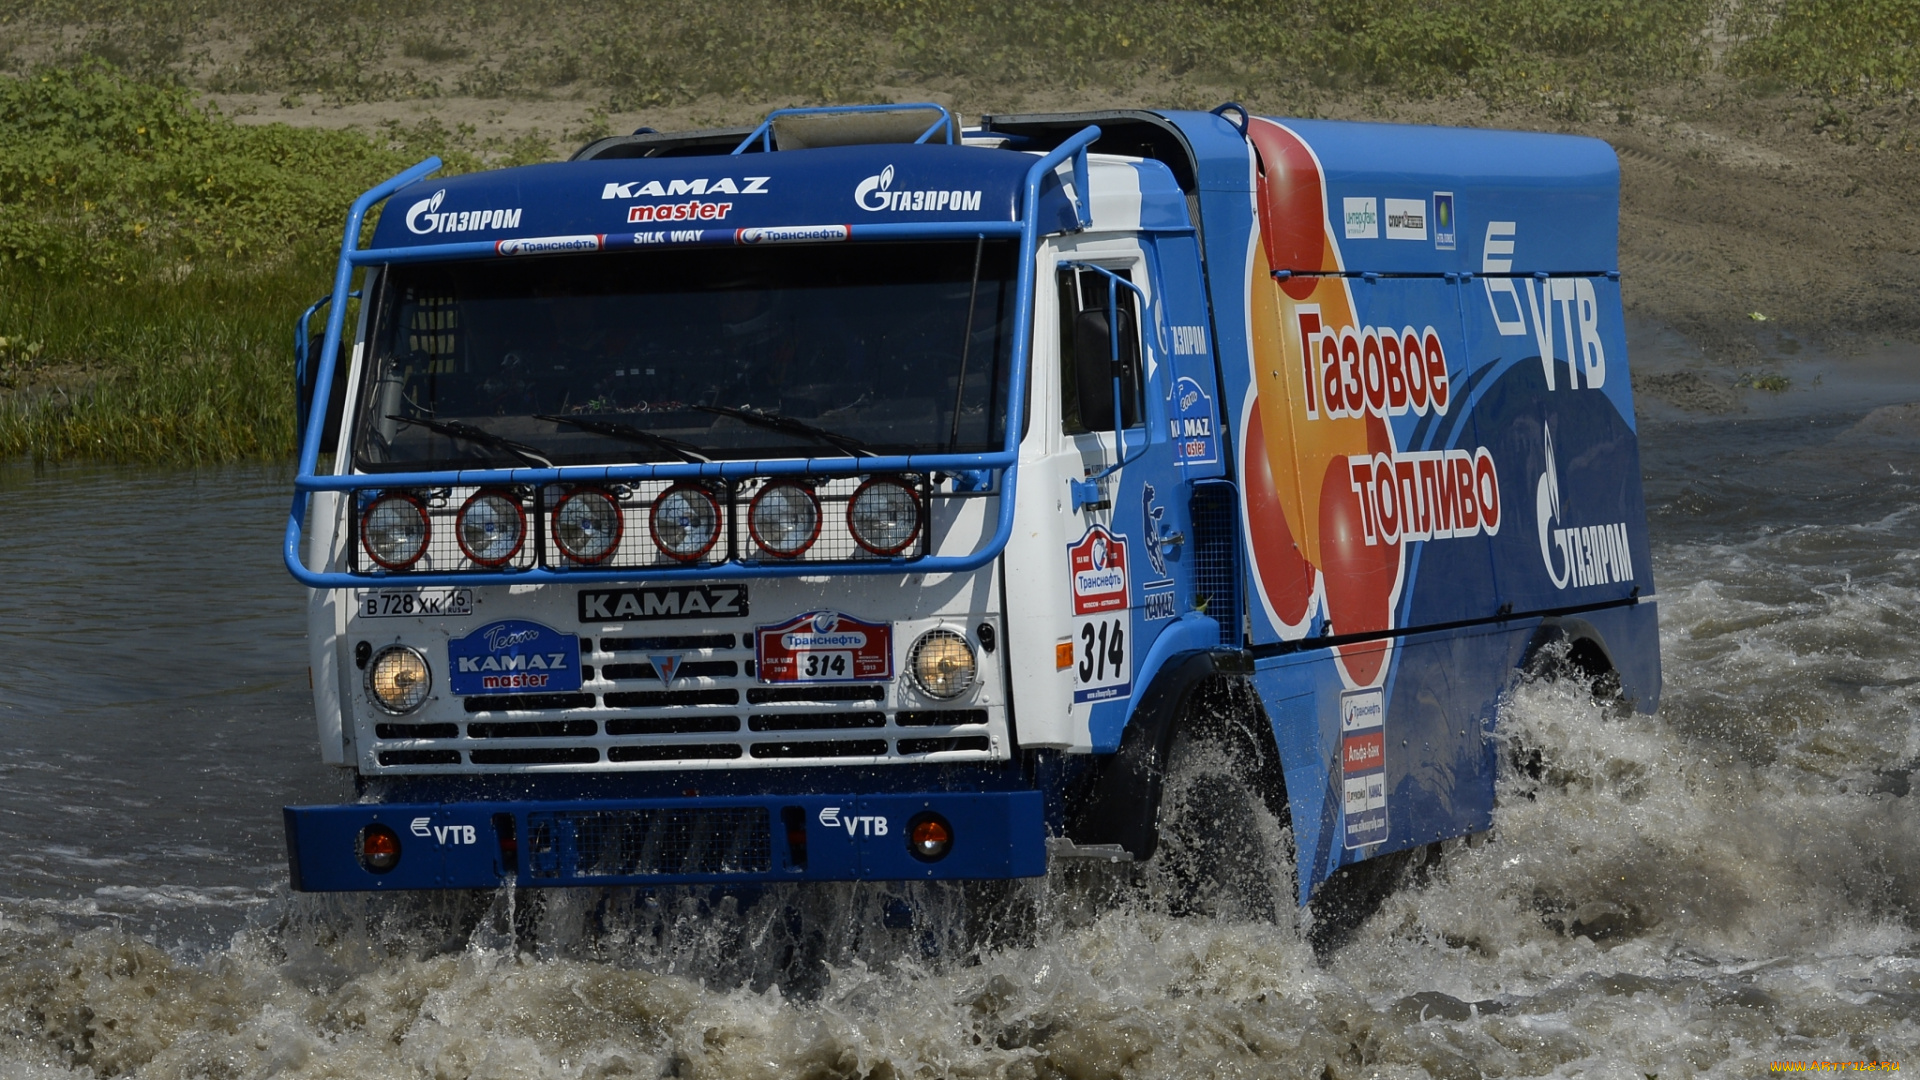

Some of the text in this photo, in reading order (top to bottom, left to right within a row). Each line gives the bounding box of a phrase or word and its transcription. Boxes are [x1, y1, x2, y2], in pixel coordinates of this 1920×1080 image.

[602, 177, 771, 199] KAMAZ
[890, 190, 982, 211] ГАЗПРОМ
[437, 208, 522, 233] ГАЗПРОМ
[627, 201, 732, 223] master
[633, 230, 705, 244] SILK WAY
[765, 227, 844, 241] Транснефть
[521, 239, 596, 252] Транснефть
[1169, 326, 1207, 355] АЗПРОМ
[1525, 278, 1606, 391] VTB
[1295, 304, 1450, 420] Газовое
[1566, 522, 1634, 588] ГАЗПРОМ
[1078, 573, 1121, 592] Транснефть
[585, 589, 739, 618] KAMAZ
[1144, 591, 1175, 621] KAMAZ
[484, 625, 539, 652] Team
[787, 635, 861, 647] Транснефть
[1079, 619, 1124, 683] 314
[458, 653, 567, 673] KAMAZ
[805, 655, 845, 676] 314
[482, 672, 549, 689] master
[1353, 703, 1381, 719] Транснефть
[434, 825, 476, 845] VTB
[843, 816, 888, 836] VTB
